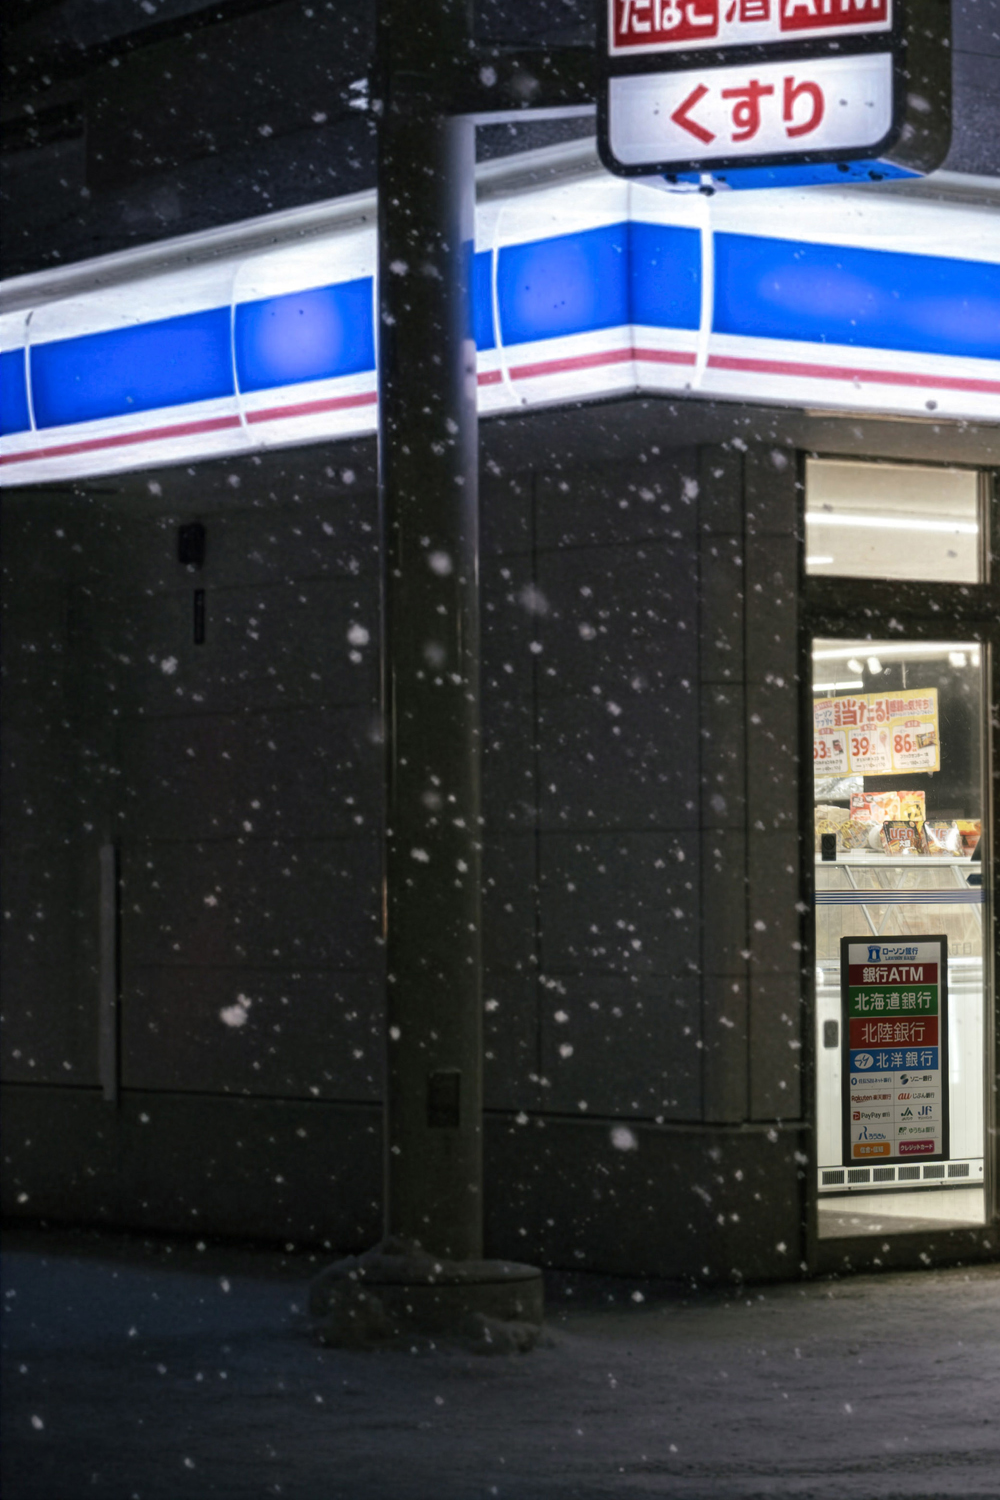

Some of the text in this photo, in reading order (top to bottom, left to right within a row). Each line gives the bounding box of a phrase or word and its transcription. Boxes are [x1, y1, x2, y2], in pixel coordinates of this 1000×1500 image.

[670, 76, 825, 145] くすり
[851, 736, 869, 756] 39
[894, 733, 911, 753] 86
[882, 947, 918, 956] ローソン銀行
[862, 966, 924, 983] 銀行ATM
[854, 991, 932, 1011] 北海道銀行
[861, 1021, 926, 1043] 北陸銀行
[876, 1051, 933, 1069] 北洋銀行
[900, 1144, 933, 1152] クレジットカード
